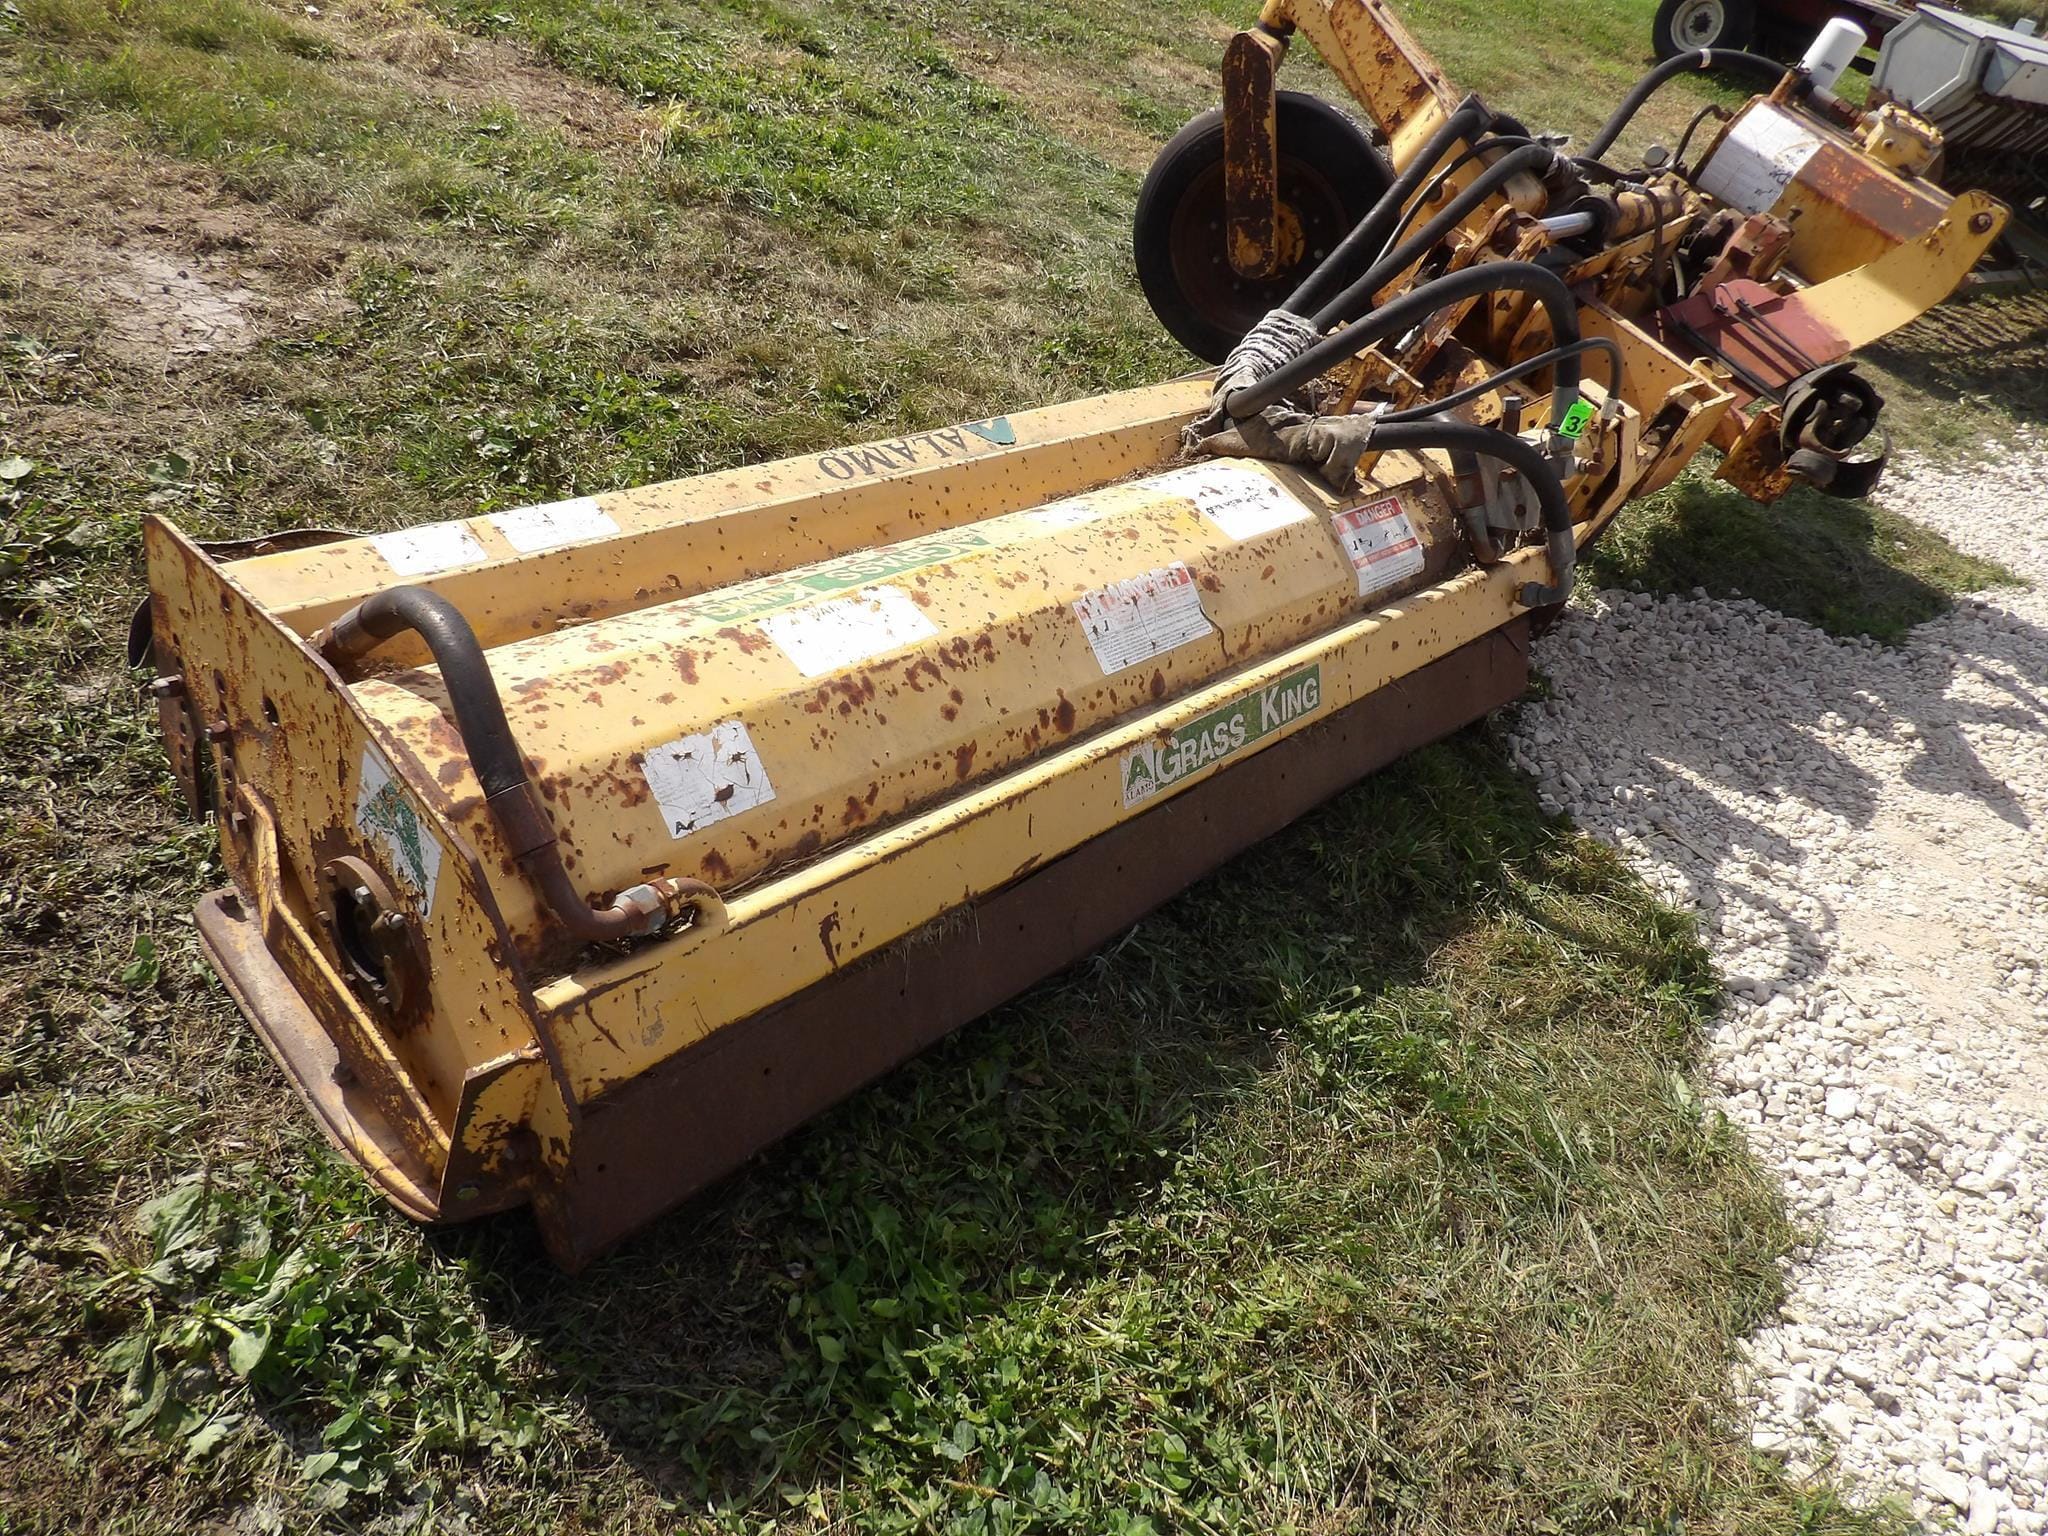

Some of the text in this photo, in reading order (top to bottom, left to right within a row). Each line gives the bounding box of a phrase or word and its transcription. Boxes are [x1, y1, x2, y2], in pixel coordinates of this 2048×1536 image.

[818, 428, 968, 480] ALAMO
[1355, 502, 1395, 524] DANGER
[824, 543, 961, 580] GRASS
[1155, 713, 1246, 784] GRASS
[1259, 677, 1318, 732] KING
